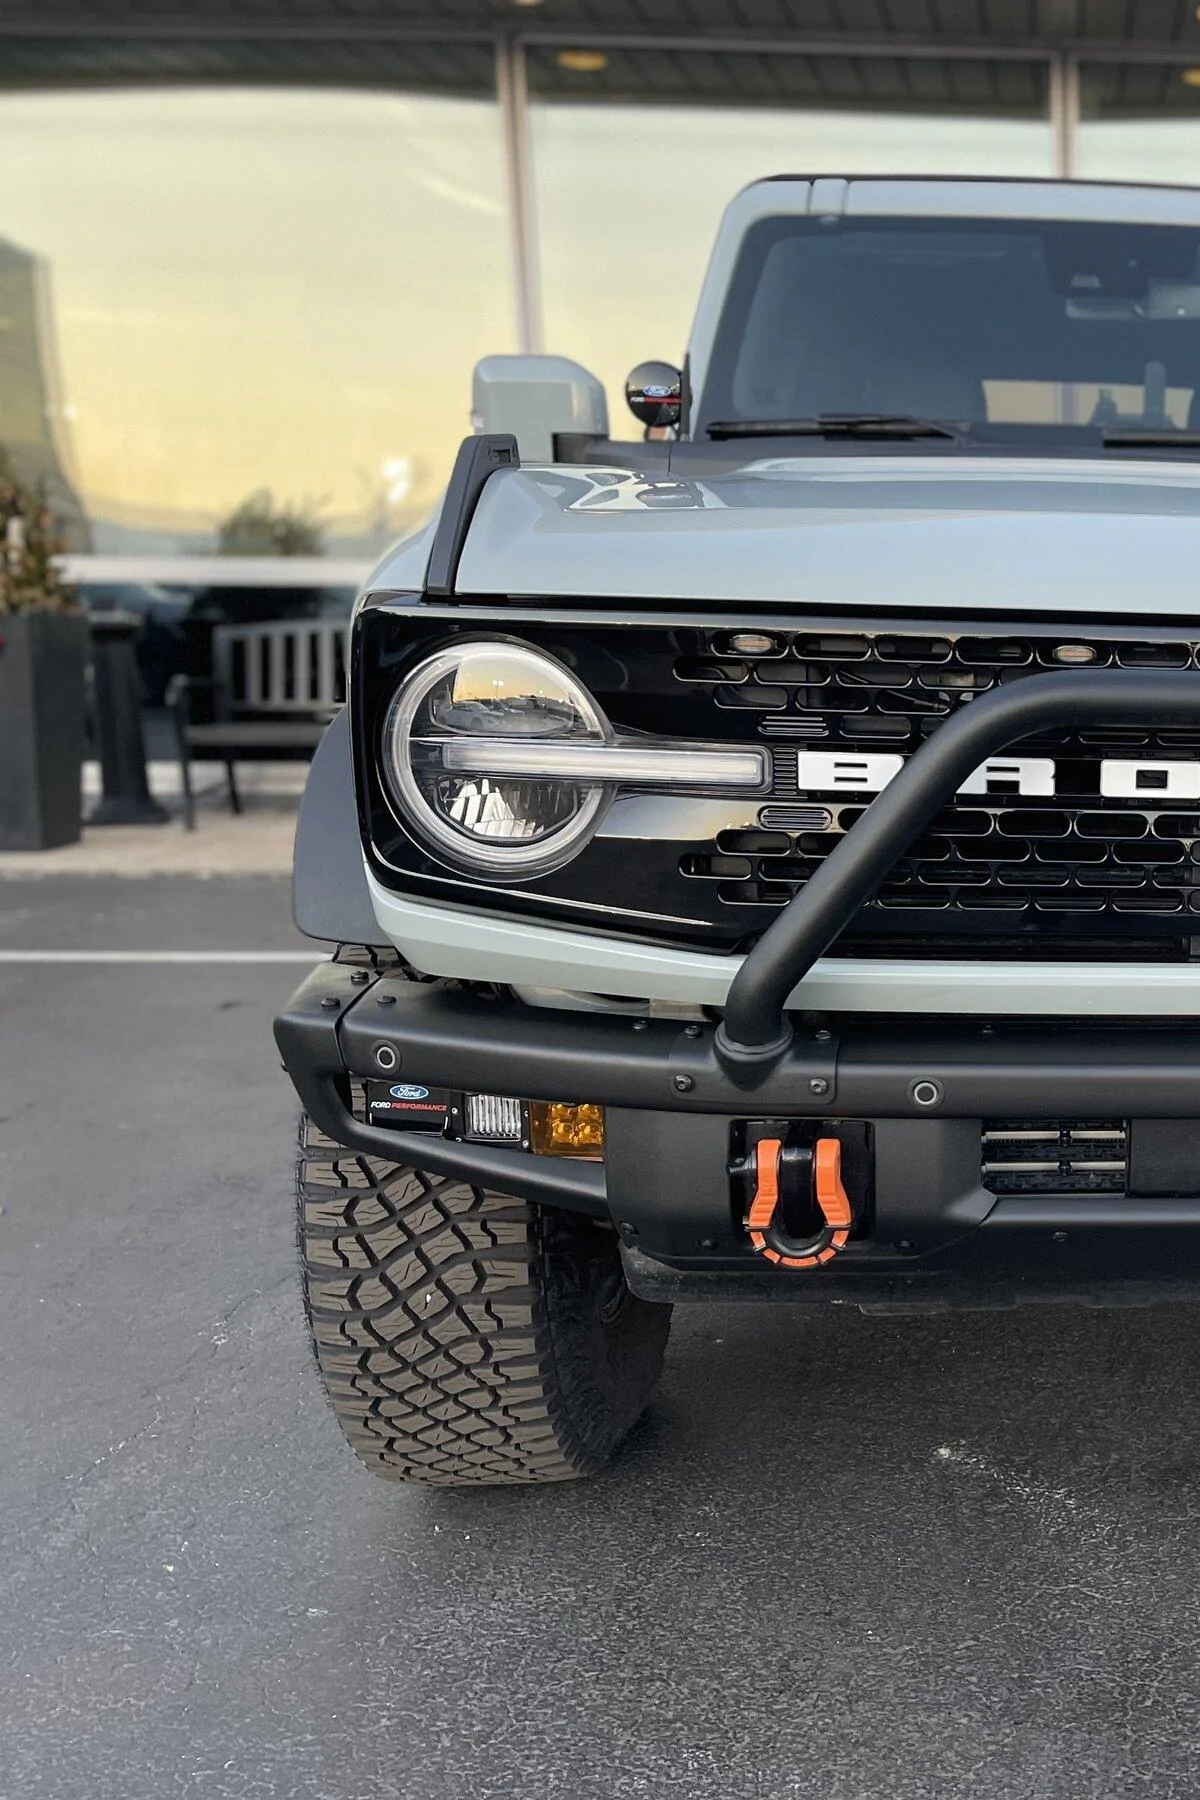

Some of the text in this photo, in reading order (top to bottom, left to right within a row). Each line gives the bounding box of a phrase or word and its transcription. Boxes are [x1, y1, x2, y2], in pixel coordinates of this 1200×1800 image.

[394, 1085, 424, 1098] Ford
[370, 1101, 447, 1111] FORD PERFORMANCE
